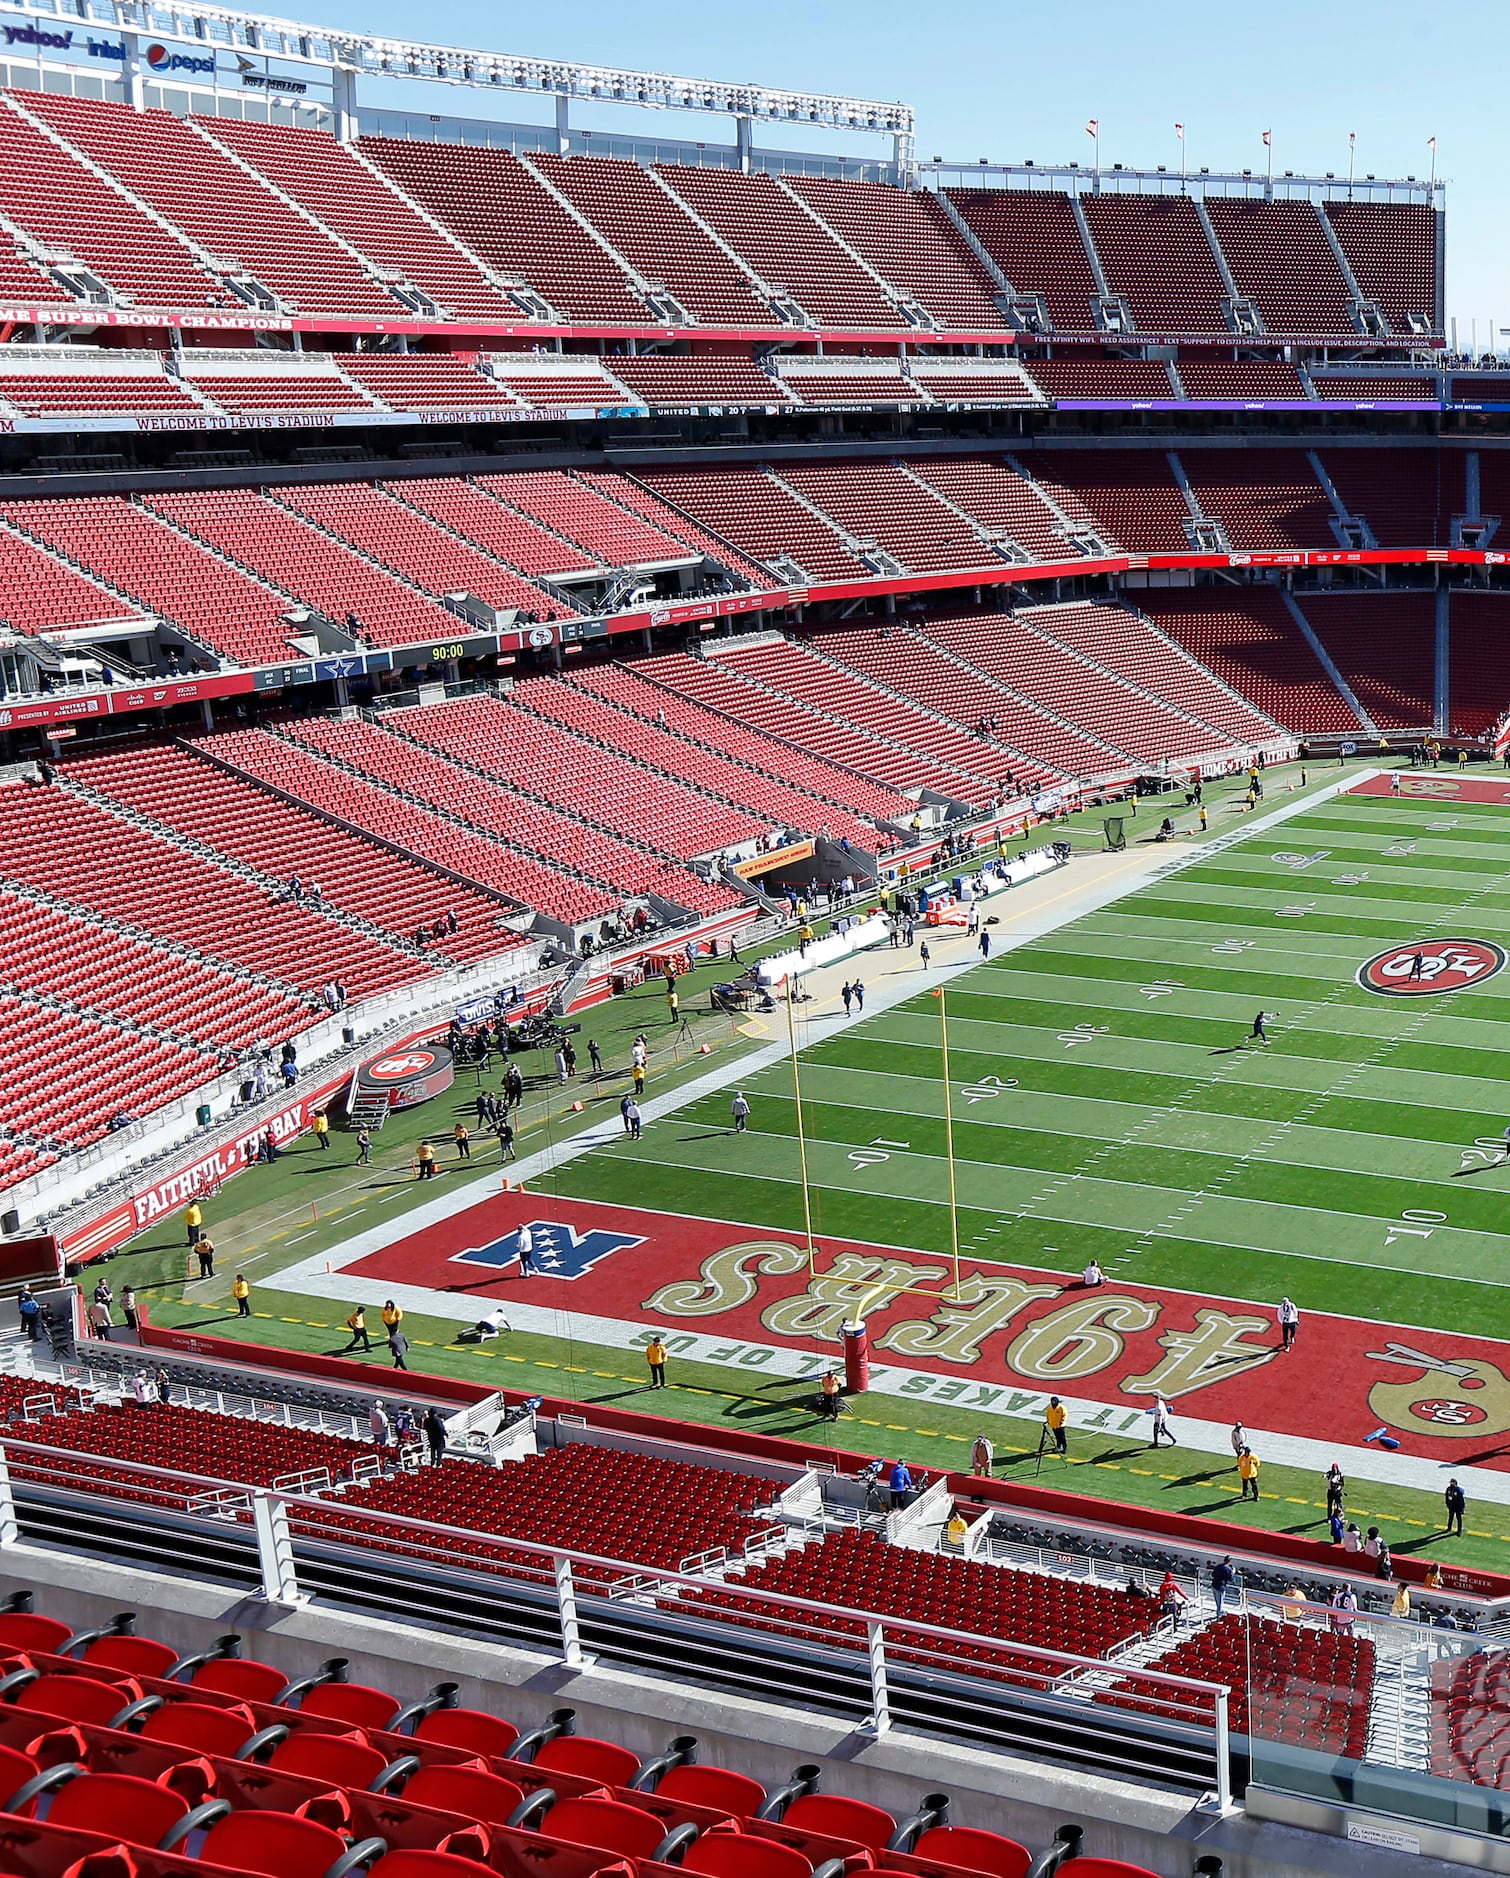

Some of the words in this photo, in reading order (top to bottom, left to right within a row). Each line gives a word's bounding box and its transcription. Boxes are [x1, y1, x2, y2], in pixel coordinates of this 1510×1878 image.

[3, 24, 72, 49] yahoo!
[87, 36, 127, 61] intel
[171, 54, 215, 73] pepsi
[37, 311, 110, 325] SUPER
[116, 314, 175, 327] BOWL
[183, 316, 293, 330] CHAMPIONS
[728, 407, 738, 415] 20
[785, 406, 794, 414] 27
[1131, 402, 1153, 410] yahoo!
[1244, 402, 1265, 410] yahoo!
[1354, 402, 1376, 410] yahoo!
[136, 418, 207, 431] WELCOME
[209, 417, 227, 430] TO
[231, 416, 275, 429] LEVI'S
[278, 415, 335, 428] STADIUM
[418, 412, 470, 424] WELCOME
[473, 412, 486, 423] TO
[489, 411, 521, 423] LEVI'S
[524, 410, 568, 422] STADIUM
[432, 644, 463, 660] 90:00
[17, 711, 40, 720] PRESENTED
[54, 708, 87, 716] AIRLINES
[59, 703, 86, 711] UNITED
[1199, 761, 1227, 777] HOME
[1233, 757, 1254, 770] THE
[1144, 850, 1208, 878] INSPIRE
[1202, 827, 1258, 851] CHANGE
[1211, 938, 1256, 955] 50
[1138, 978, 1186, 997] 40
[1056, 1022, 1110, 1044] 30
[960, 1075, 1019, 1100] 20
[847, 1136, 911, 1165] 10
[134, 1152, 227, 1225] FAITHFUL
[271, 1103, 303, 1139] BAY
[1388, 1209, 1449, 1239] 10
[642, 1240, 1275, 1400] 49ERS
[628, 1329, 698, 1355] US
[707, 1345, 775, 1366] OF
[899, 1376, 1050, 1416] TAKES
[1082, 1407, 1140, 1431] IT
[1453, 1582, 1474, 1590] CLUB
[1469, 1577, 1493, 1587] CREEK
